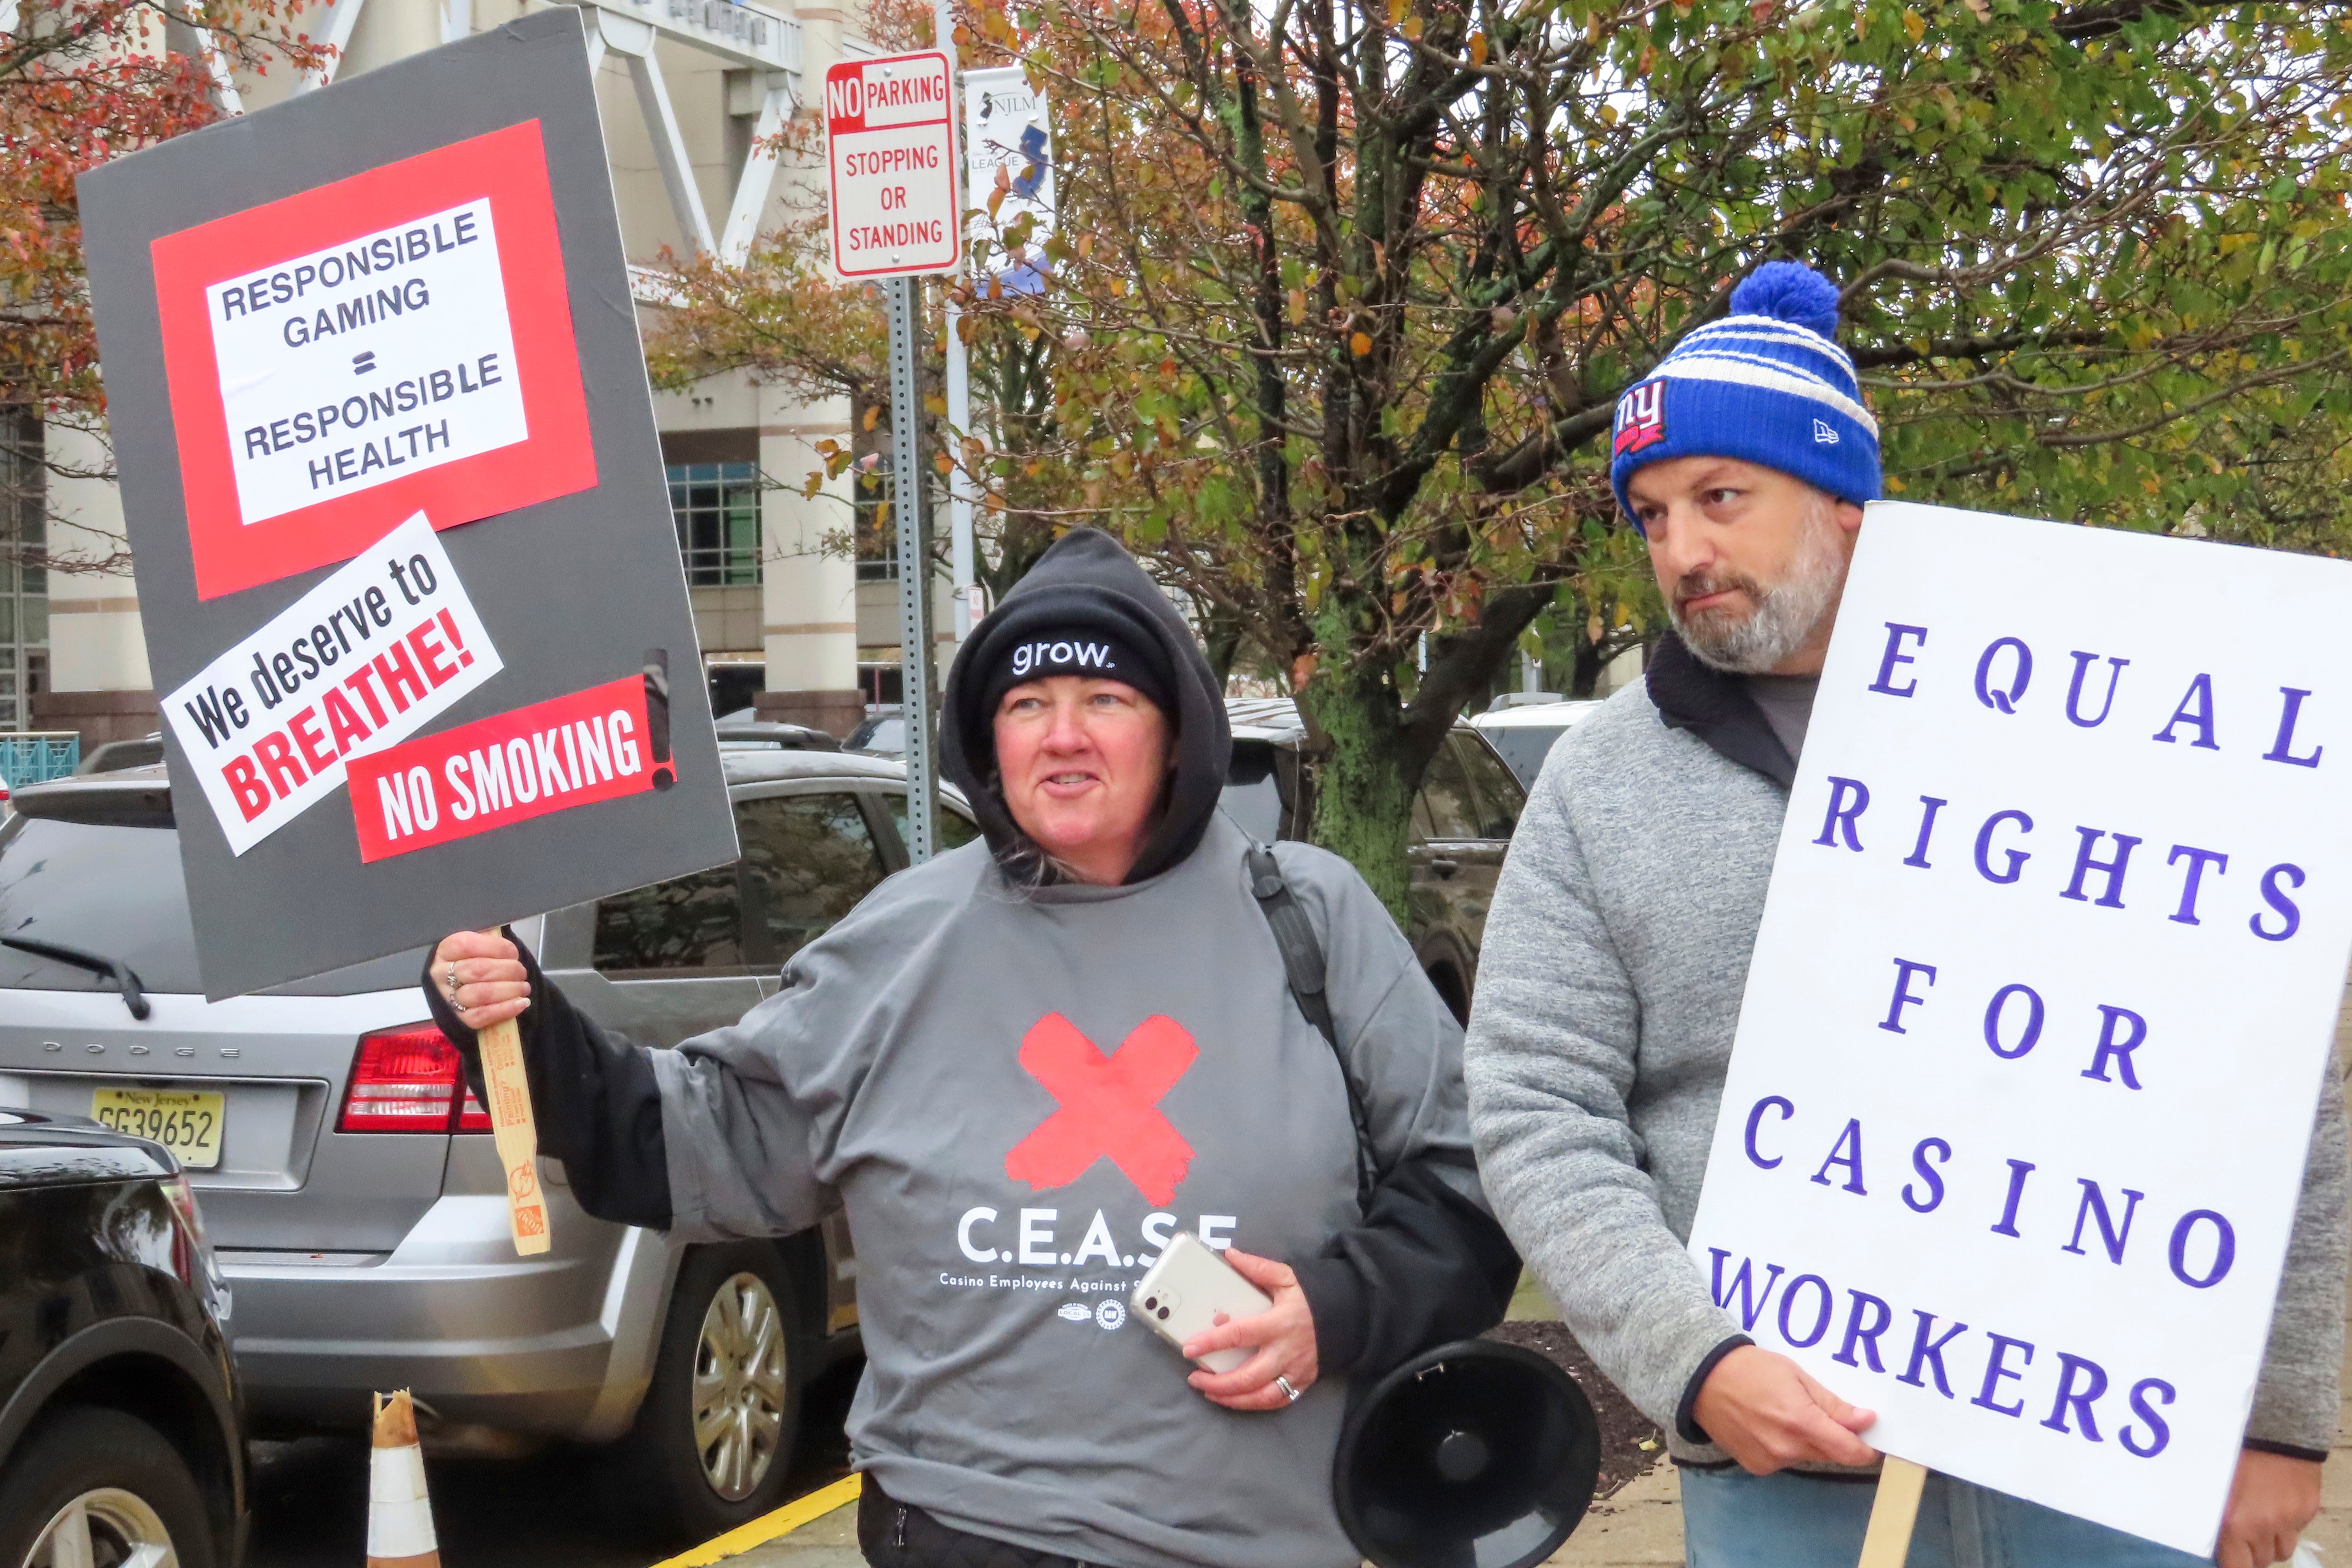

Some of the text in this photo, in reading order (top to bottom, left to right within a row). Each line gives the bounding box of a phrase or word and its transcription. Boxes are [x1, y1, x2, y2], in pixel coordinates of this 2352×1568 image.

[830, 75, 944, 119] NO PARKING
[994, 96, 1037, 116] NJLM
[846, 145, 938, 177] STOPPING
[971, 156, 1019, 169] LEAGUE
[881, 186, 906, 210] OR
[222, 212, 478, 320] RESPONSIBLE
[850, 220, 942, 250] STANDING
[284, 278, 429, 347] GAMING
[353, 352, 376, 375] =
[245, 354, 500, 459] RESPONSIBLE
[309, 420, 449, 489] HEALTH
[185, 554, 437, 749] We deserve to
[1012, 641, 1115, 676] grow.
[222, 607, 475, 823] BREATHE!
[1868, 622, 2323, 768] EQUAL
[377, 766, 438, 840] NO
[1812, 776, 2305, 942] RIGHTS
[43, 1041, 240, 1057] DODGE
[1879, 957, 2147, 1090] FOR
[1745, 1096, 2235, 1289] CASINO
[940, 1272, 984, 1287] Casino
[990, 1274, 1064, 1292] Employees
[1070, 1277, 1127, 1293] Against
[1707, 1247, 2176, 1458] WORKERS
